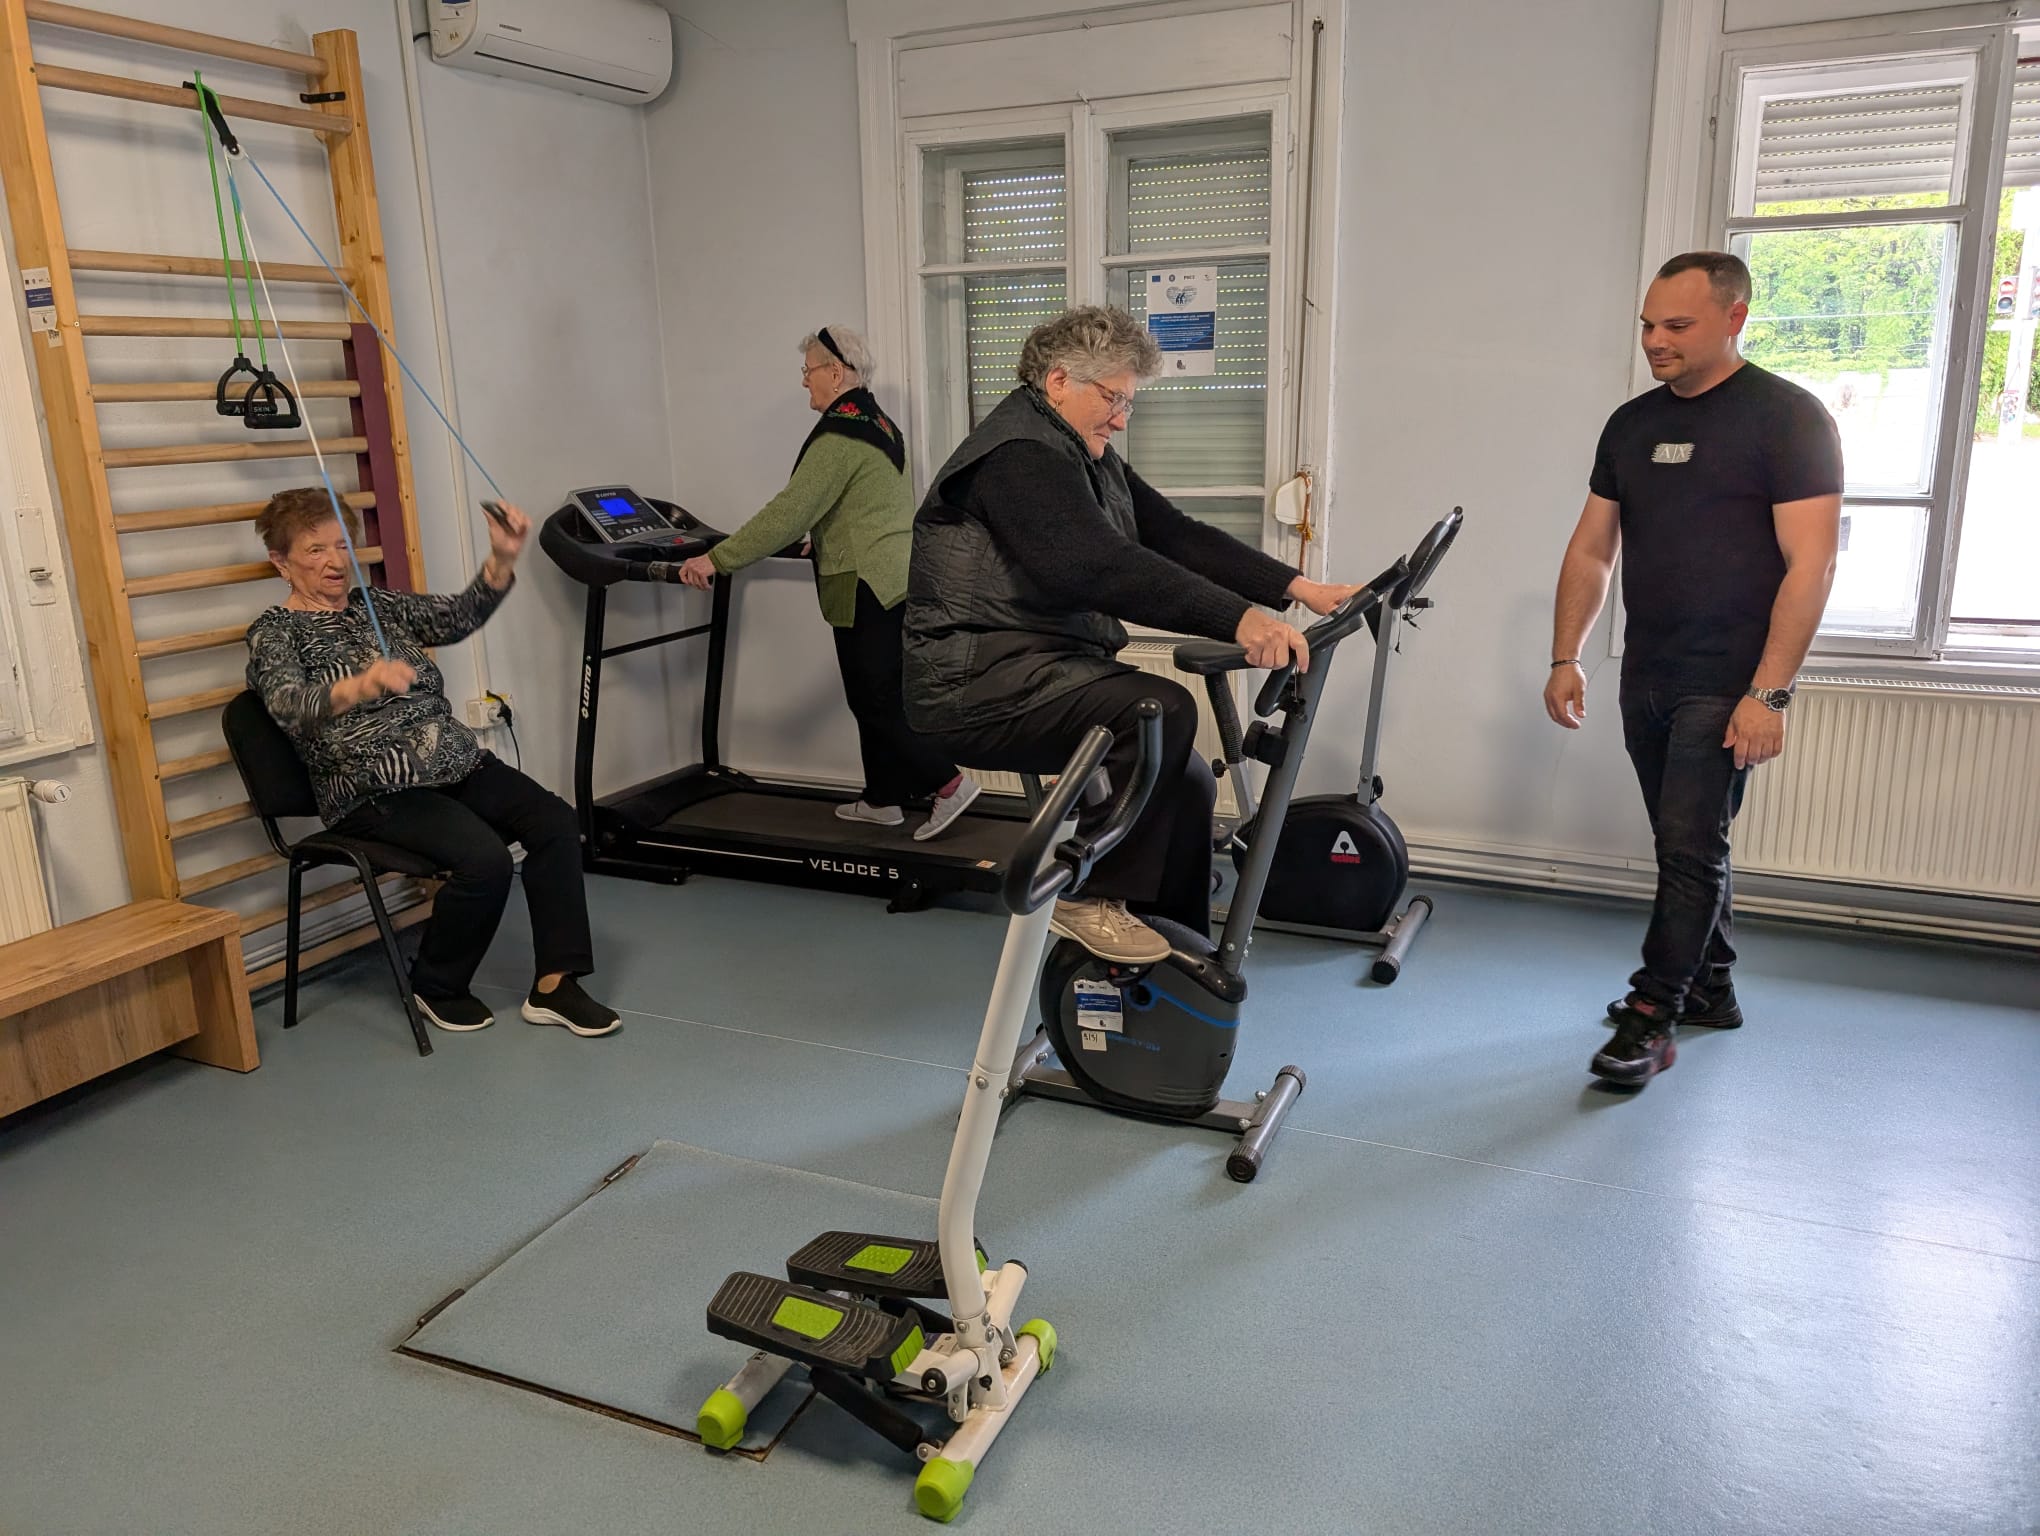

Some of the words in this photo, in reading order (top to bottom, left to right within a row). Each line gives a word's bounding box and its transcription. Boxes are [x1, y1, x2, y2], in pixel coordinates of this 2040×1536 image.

[582, 664, 592, 708] LOTTO
[809, 858, 880, 877] VELOCE
[888, 868, 899, 879] 5
